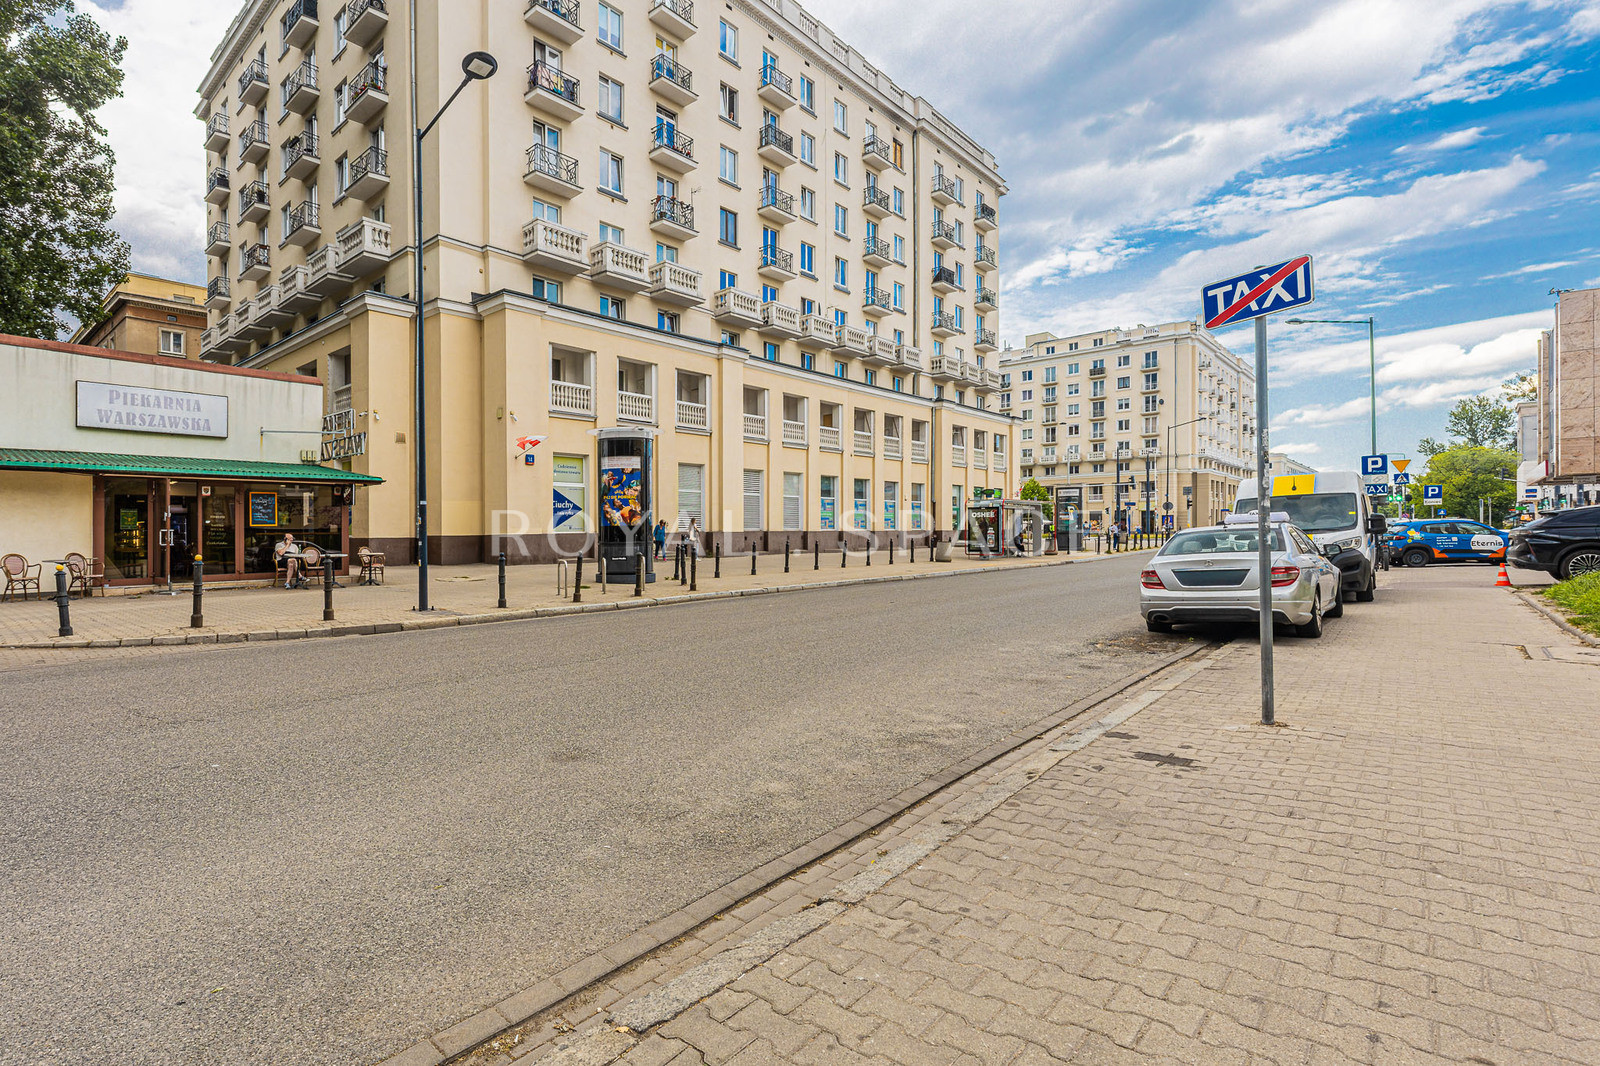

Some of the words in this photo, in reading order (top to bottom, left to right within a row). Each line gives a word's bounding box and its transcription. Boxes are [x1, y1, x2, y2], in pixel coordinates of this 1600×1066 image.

[1207, 262, 1306, 315] TAXI
[108, 389, 202, 413] PIEKARNIA
[96, 408, 212, 432] WARSZAWSKA
[1367, 457, 1383, 473] P
[1365, 485, 1388, 494] TAXI
[1428, 486, 1439, 498] P
